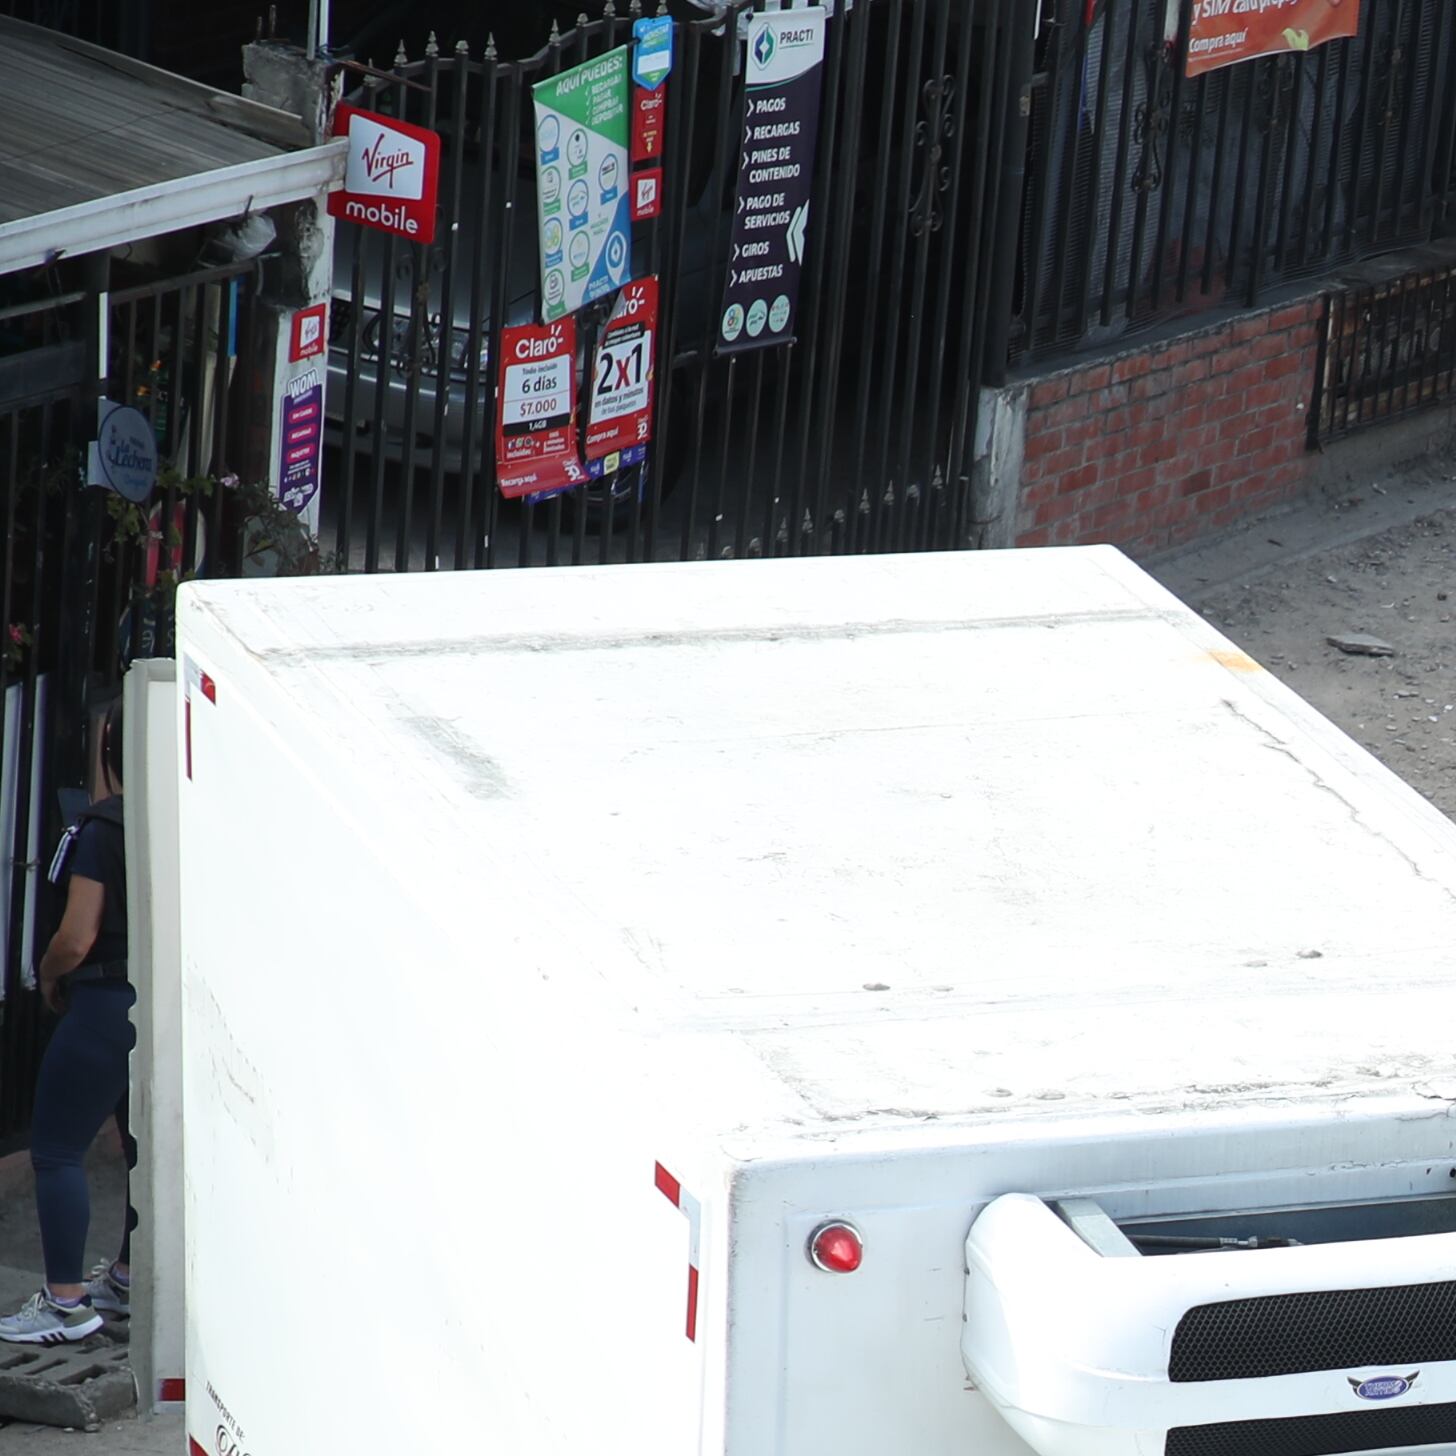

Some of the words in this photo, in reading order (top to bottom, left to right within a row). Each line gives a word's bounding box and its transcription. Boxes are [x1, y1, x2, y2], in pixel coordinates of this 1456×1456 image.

[1193, 4, 1199, 24] y
[1202, 0, 1229, 18] SIM
[780, 29, 814, 44] PRACTI
[1189, 37, 1223, 54] Compra
[1224, 28, 1248, 46] aquí
[756, 97, 786, 114] PAGOS
[753, 121, 800, 141] RECARGAS
[362, 133, 414, 189] Virgin
[751, 149, 777, 165] PINES
[779, 146, 791, 161] DE
[749, 163, 800, 183] CONTENIDO
[746, 195, 772, 210] PAGO
[772, 193, 785, 208] DE
[345, 200, 418, 234] mobile
[744, 211, 790, 229] SERVICIOS
[742, 241, 770, 258] GIROS
[739, 264, 783, 283] APUESTAS
[516, 328, 563, 358] Claro
[597, 342, 642, 395] 2x1
[289, 371, 317, 398] WOM
[522, 379, 530, 394] 6
[533, 374, 557, 393] días
[520, 398, 557, 417] $7.000
